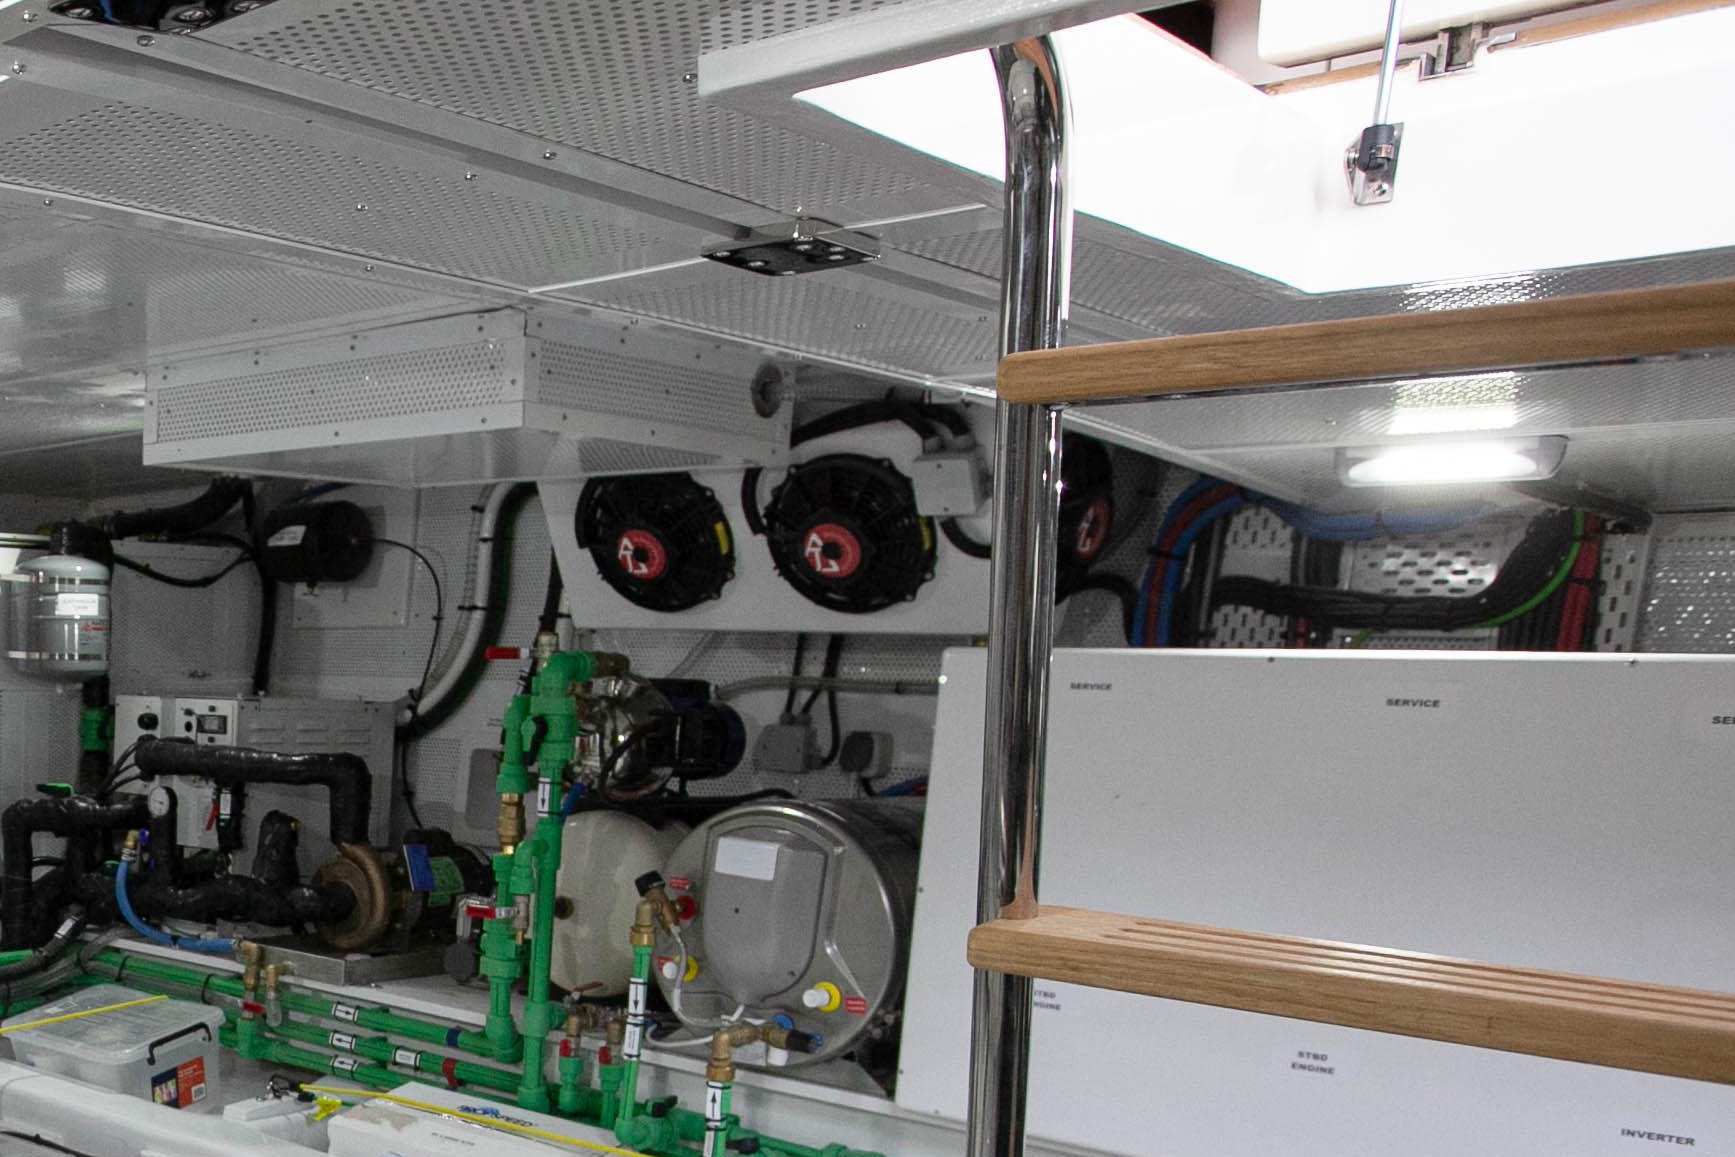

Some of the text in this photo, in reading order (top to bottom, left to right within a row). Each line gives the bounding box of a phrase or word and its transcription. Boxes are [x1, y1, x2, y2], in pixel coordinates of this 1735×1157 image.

[1386, 698, 1441, 708] SERVICE
[1291, 1062, 1335, 1074] ENGINE
[1621, 1128, 1696, 1146] INVERTER
